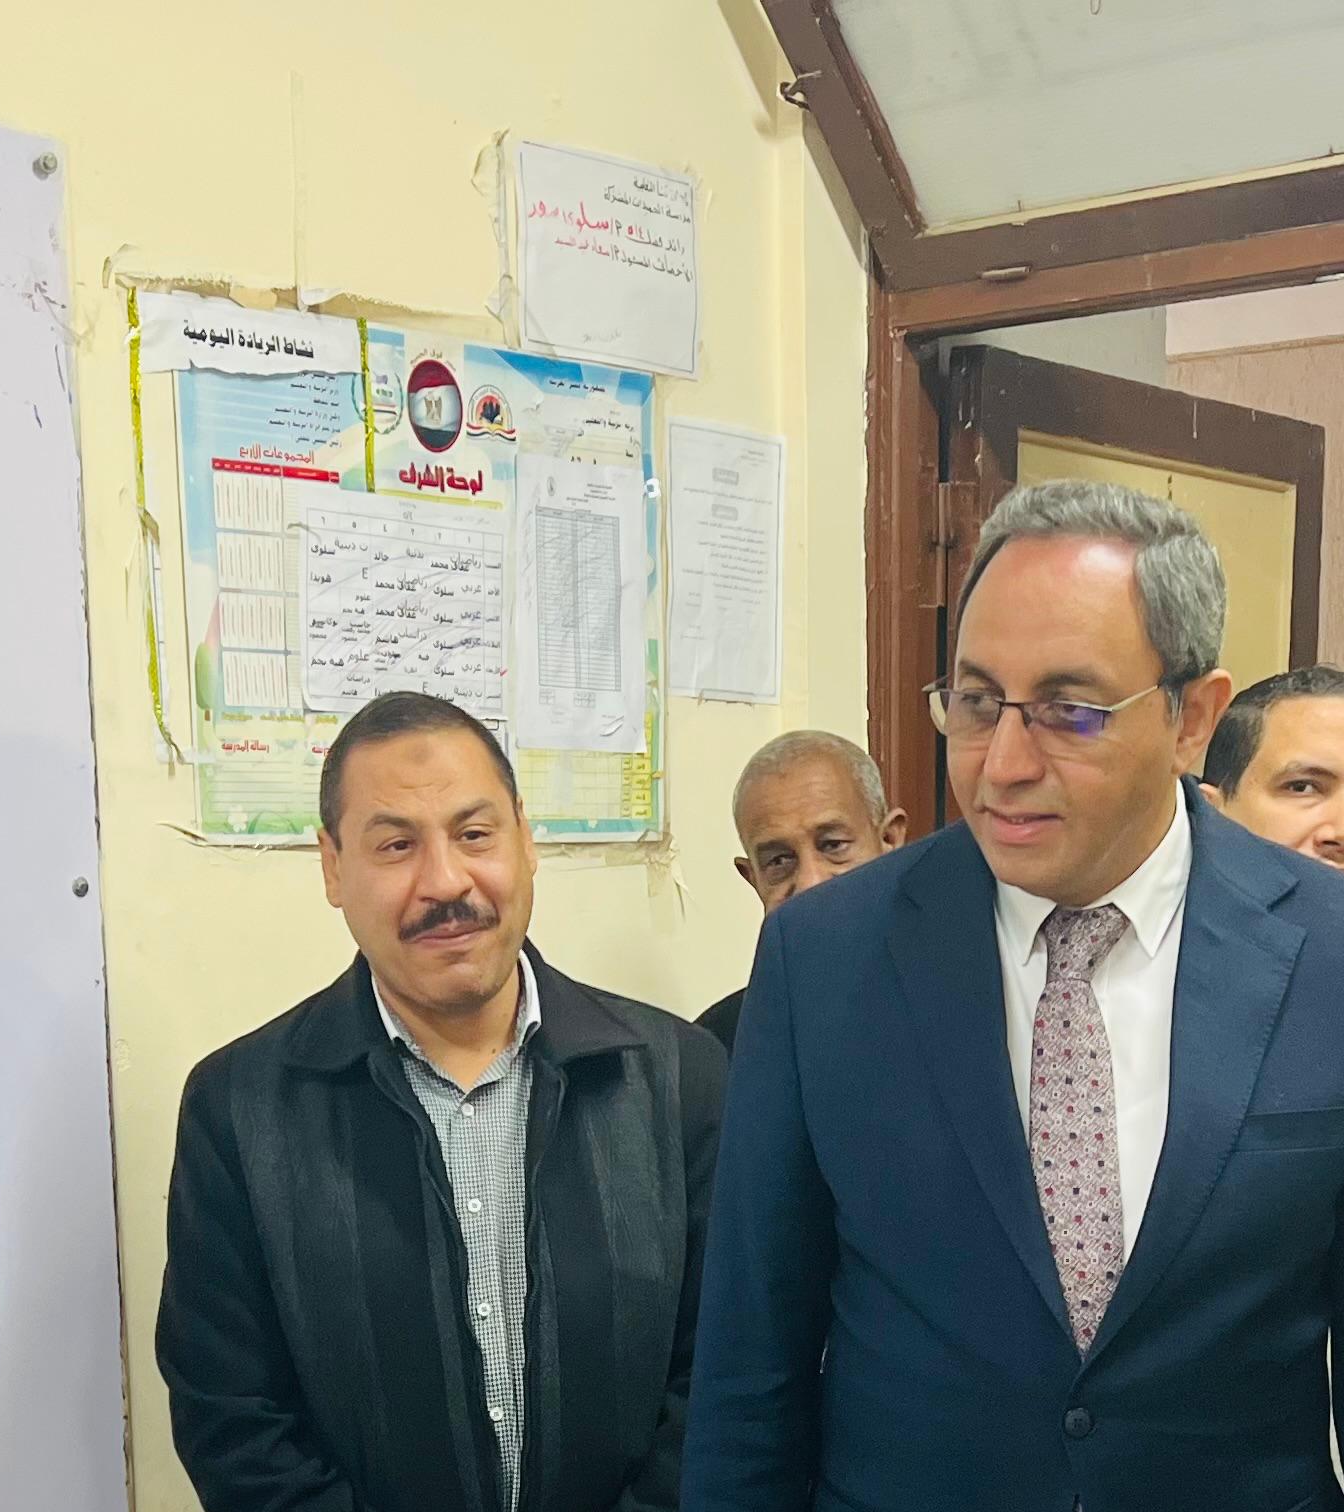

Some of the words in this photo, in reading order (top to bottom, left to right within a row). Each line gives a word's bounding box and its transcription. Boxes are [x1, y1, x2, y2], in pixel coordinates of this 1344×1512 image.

[183, 318, 234, 349] اليومية
[238, 329, 280, 356] الريادة
[283, 336, 315, 359] نشاط
[398, 461, 446, 493] الشرف
[447, 468, 484, 495] لوحة
